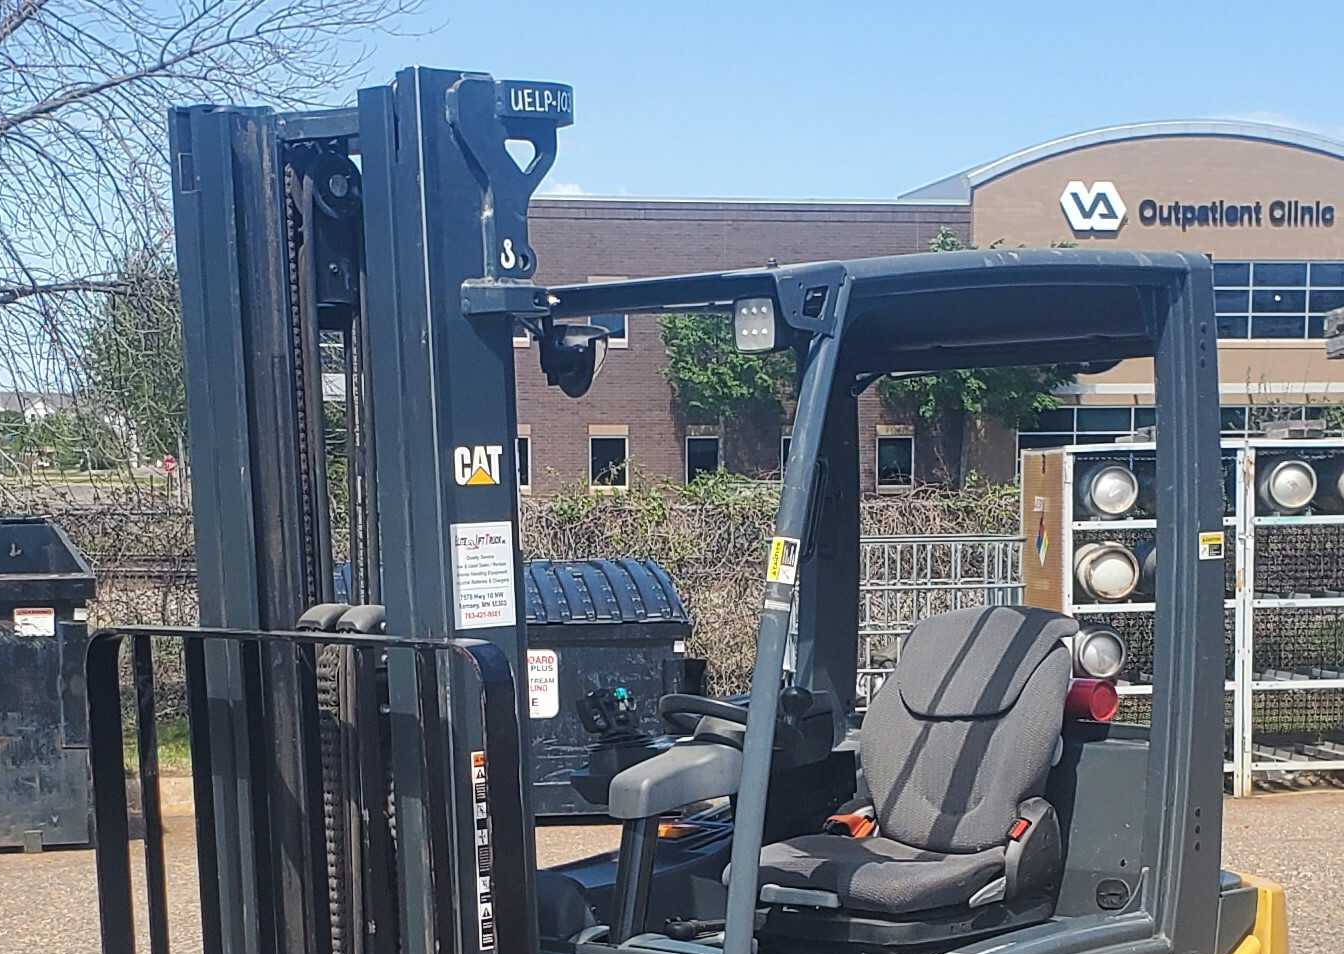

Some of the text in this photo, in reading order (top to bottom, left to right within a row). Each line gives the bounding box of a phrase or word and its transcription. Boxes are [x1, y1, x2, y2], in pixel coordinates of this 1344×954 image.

[1139, 199, 1336, 232] Outpatient Clinic
[454, 445, 503, 486] CAT
[527, 655, 555, 665] OARD
[531, 664, 553, 672] PLUS
[532, 697, 539, 707] E
